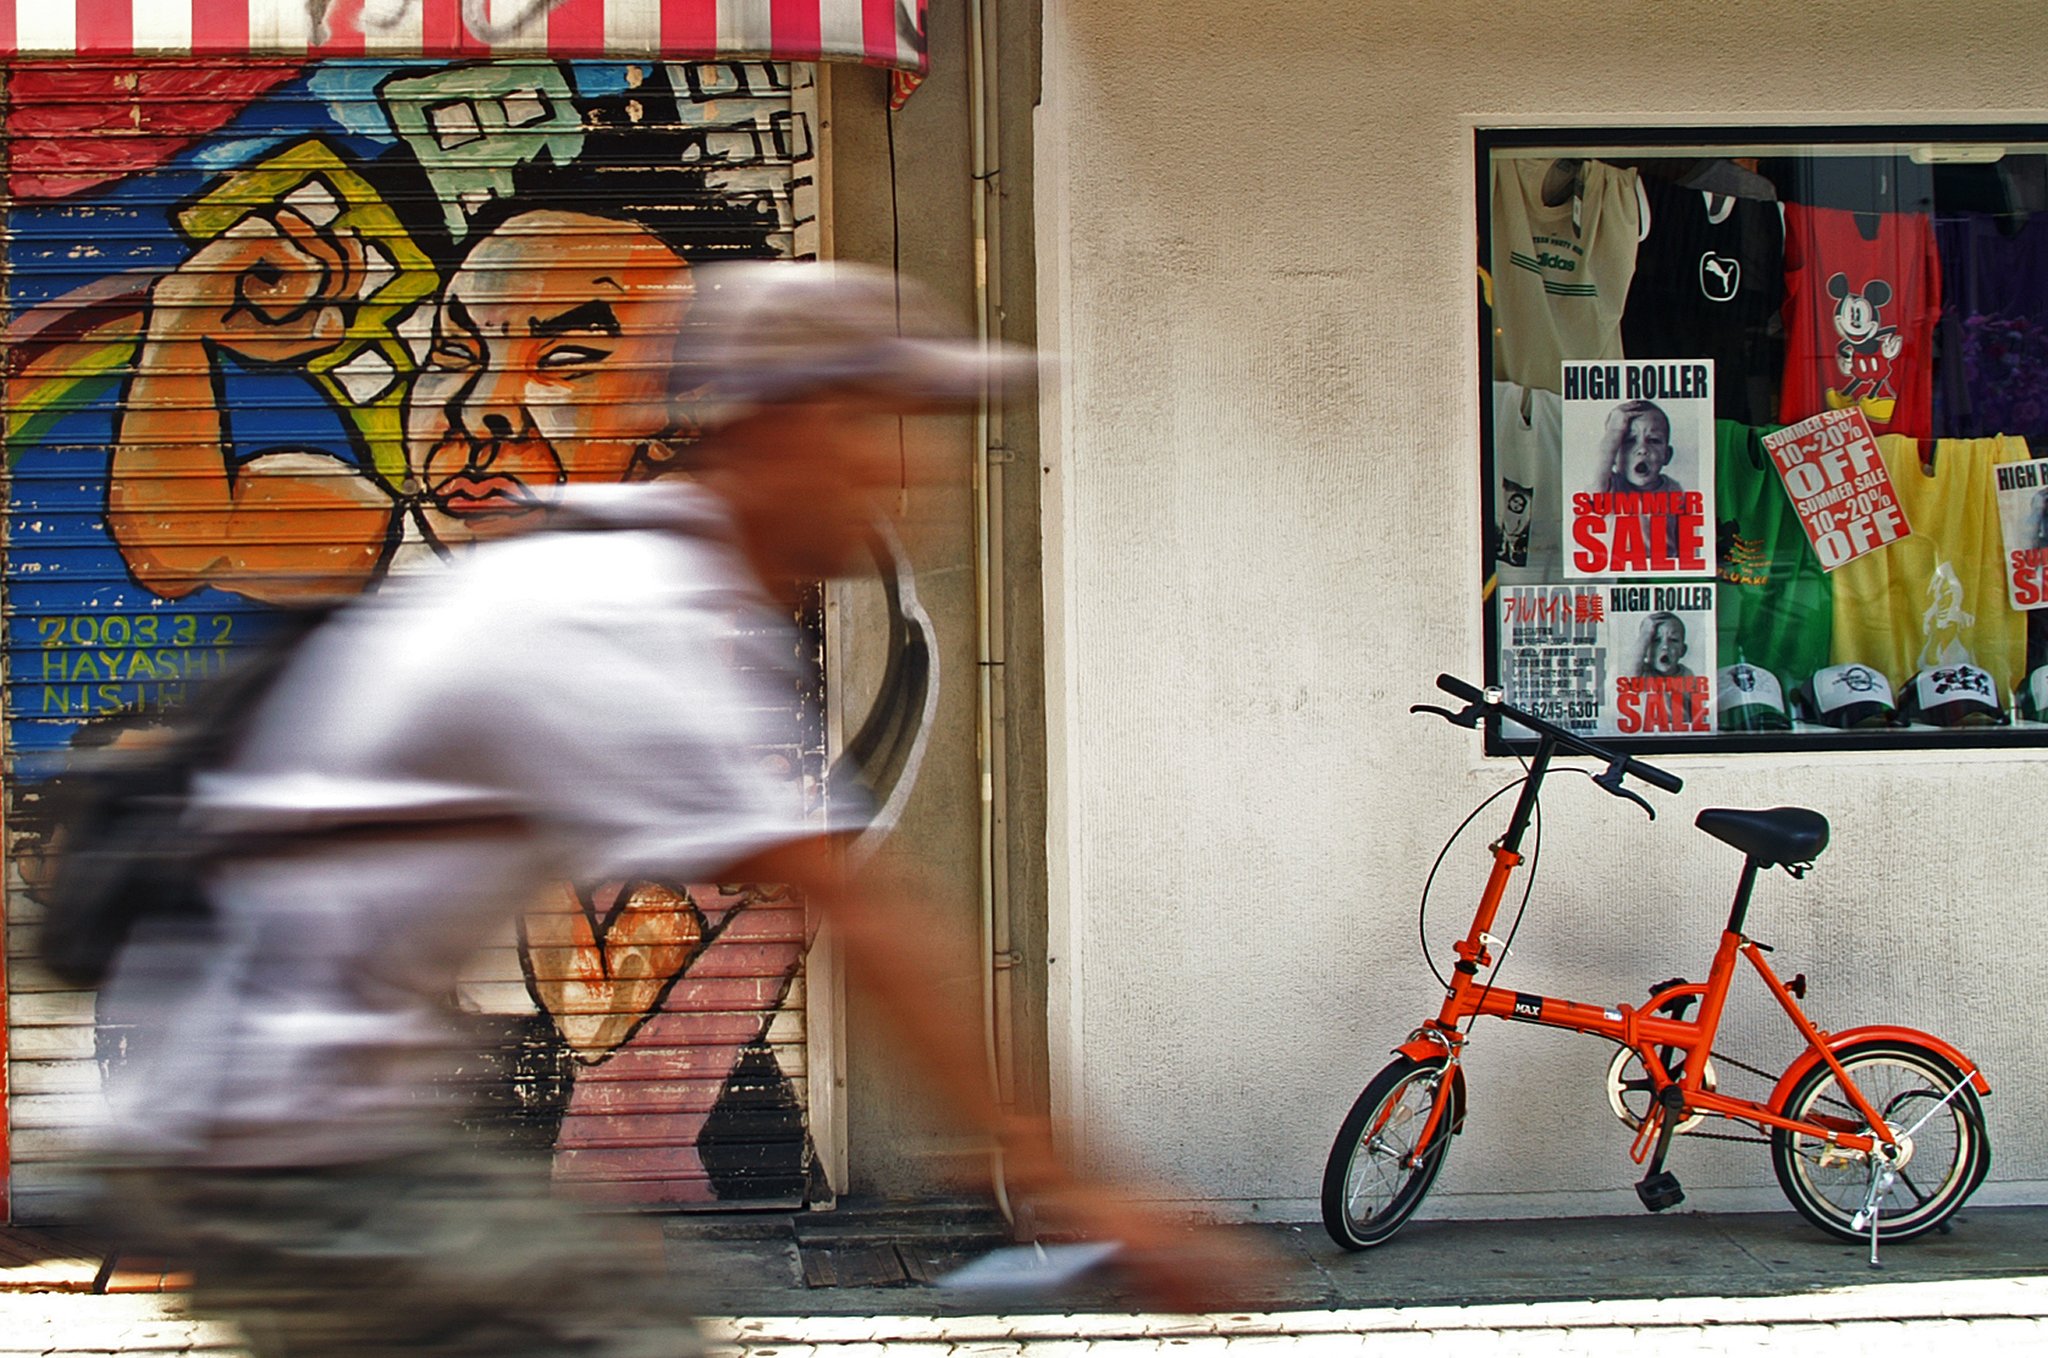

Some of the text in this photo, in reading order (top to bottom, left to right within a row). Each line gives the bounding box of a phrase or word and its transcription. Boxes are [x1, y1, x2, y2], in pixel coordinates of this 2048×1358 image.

[1564, 365, 1707, 400] HIGH ROLLER
[1765, 407, 1858, 450] SUMMER SALE
[1785, 437, 1874, 499] OFF
[1997, 464, 2038, 491] HIGH
[1572, 491, 1704, 516] SUMMER
[1798, 468, 1887, 517] SUMMER SALE
[1572, 514, 1706, 573] SALE
[1815, 505, 1901, 567] OFF
[1610, 587, 1712, 612] HIGH ROLLER
[2013, 567, 2048, 605] S
[1503, 594, 1605, 624] アルバイト募集
[1616, 676, 1709, 693] SUMMER
[1617, 692, 1711, 734] SALE
[1515, 1002, 1541, 1017] MAX
